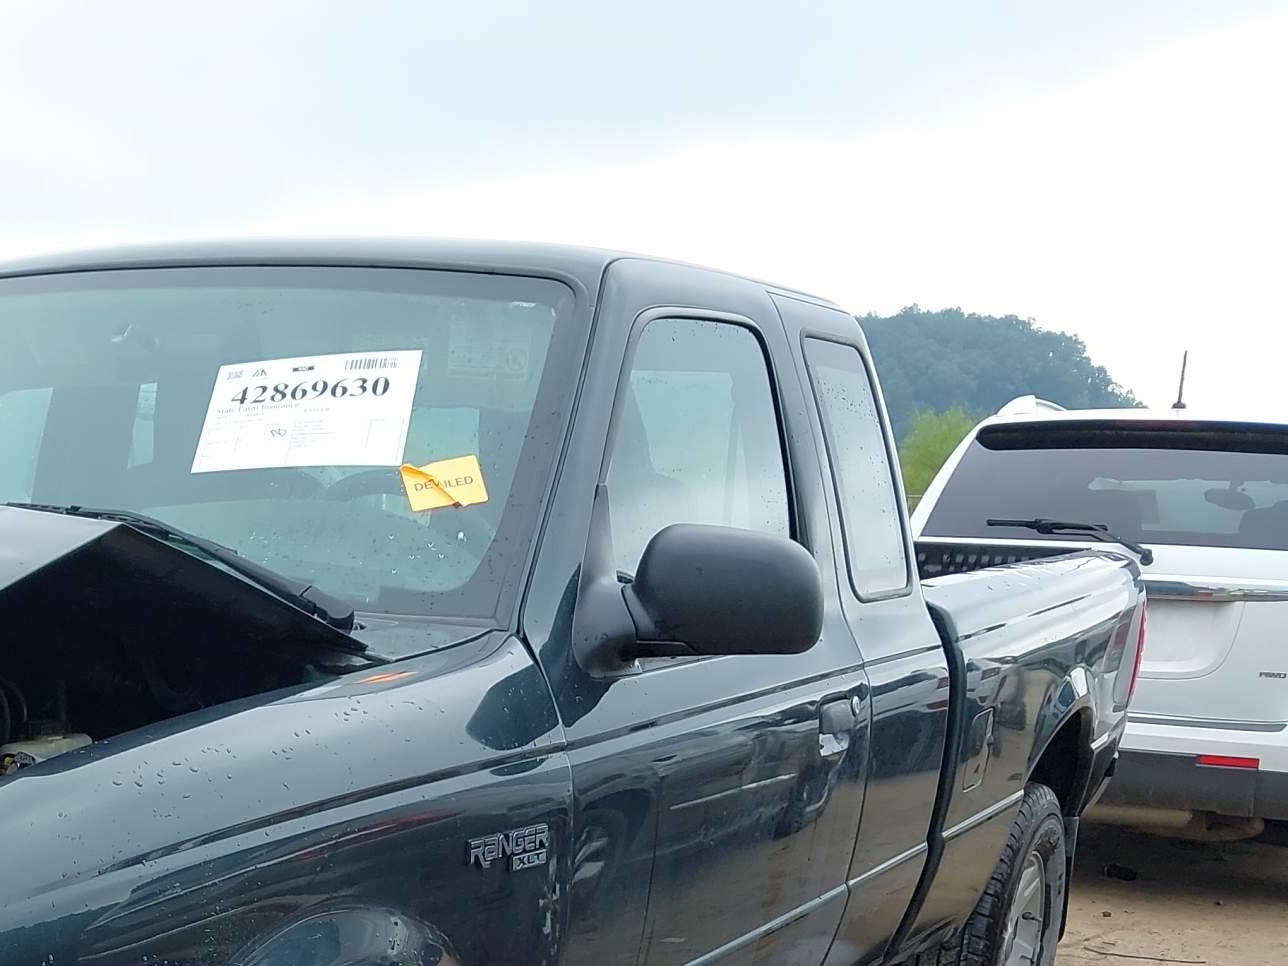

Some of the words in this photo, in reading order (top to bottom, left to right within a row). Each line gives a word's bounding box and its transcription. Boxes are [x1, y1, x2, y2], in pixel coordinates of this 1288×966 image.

[230, 376, 390, 405] 42869630
[414, 475, 474, 492] DEAILED
[468, 823, 549, 868] RANGER
